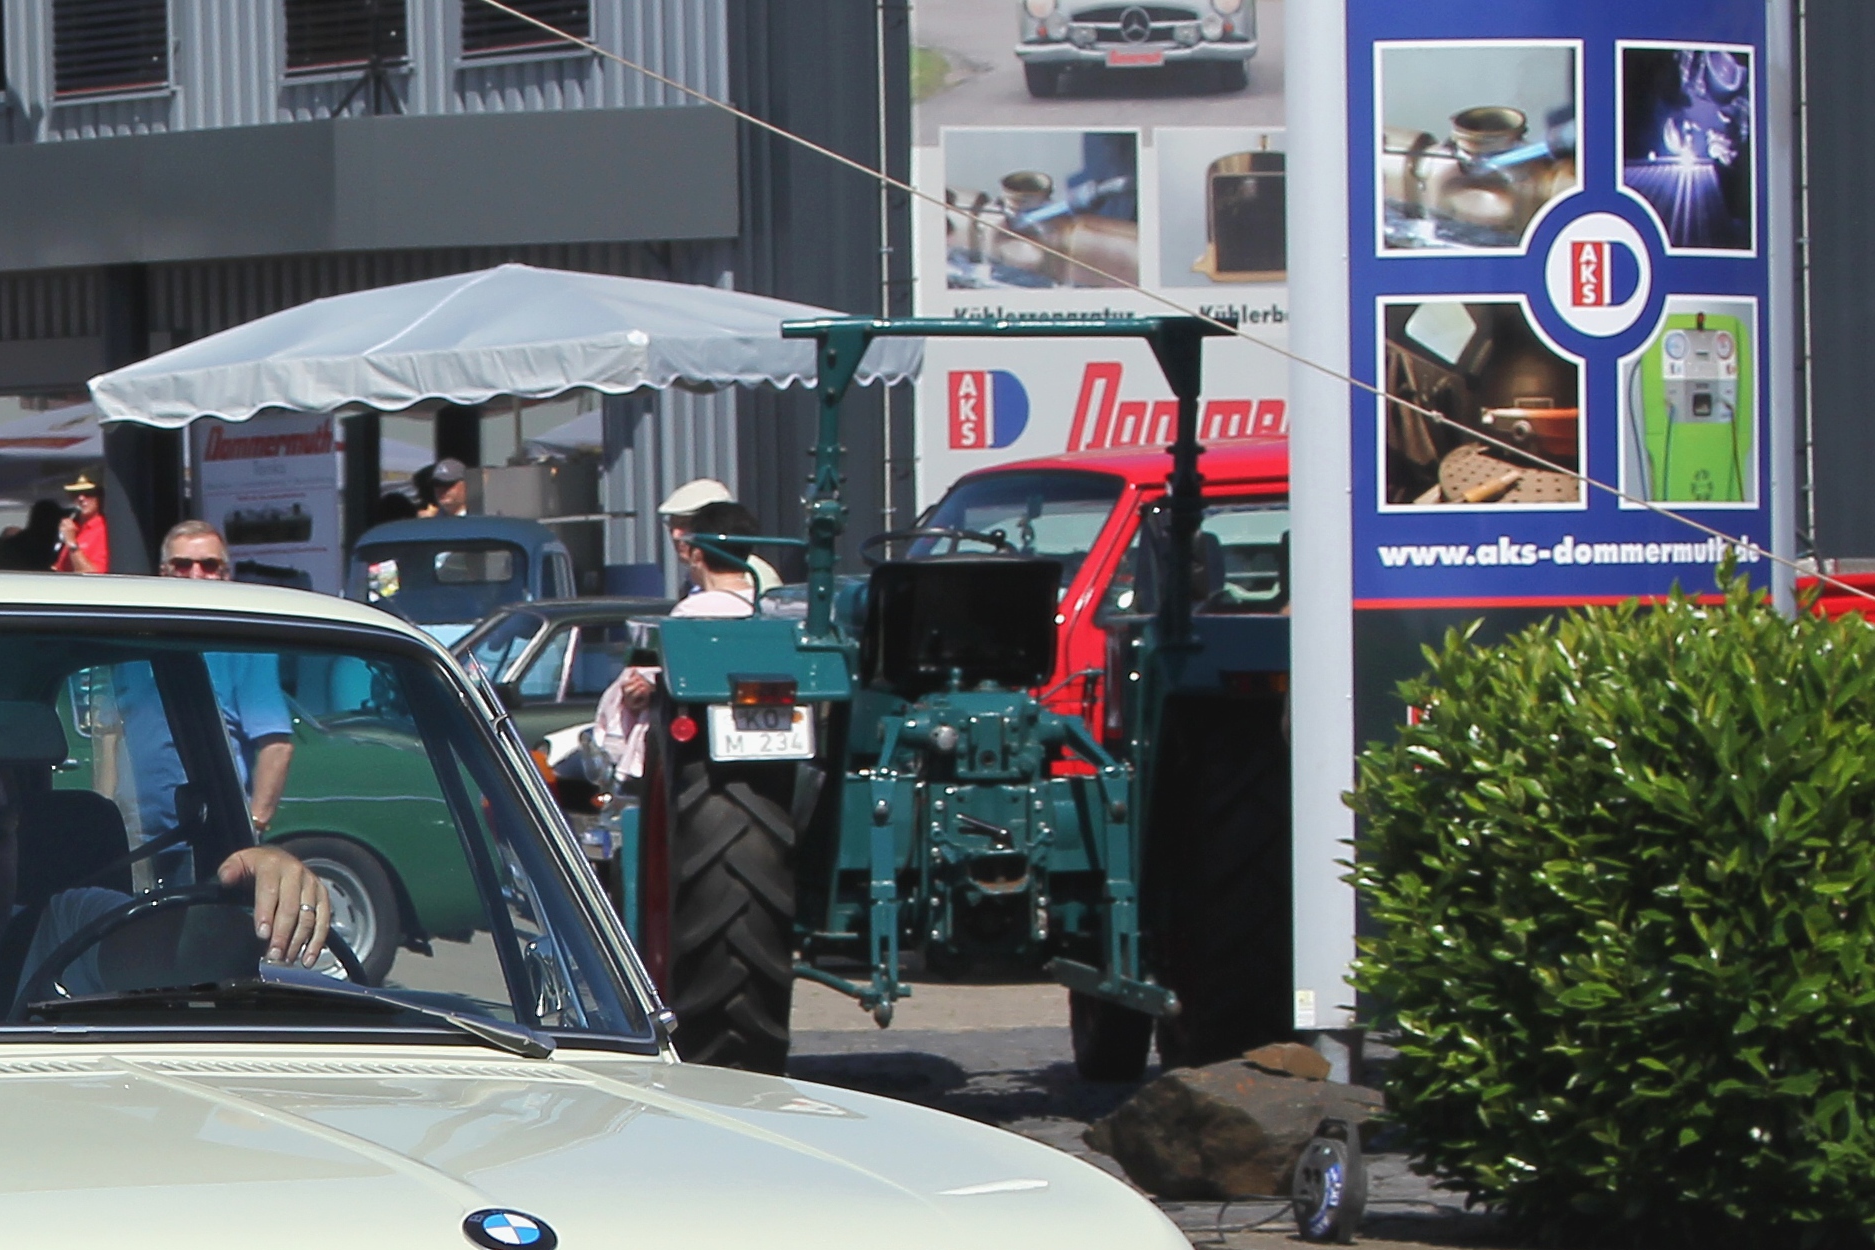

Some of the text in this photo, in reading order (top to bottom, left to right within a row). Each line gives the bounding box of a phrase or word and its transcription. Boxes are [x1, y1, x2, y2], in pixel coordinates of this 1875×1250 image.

[1578, 242, 1598, 305] AKS
[958, 373, 976, 446] AKS
[1067, 361, 1290, 452] Domme
[1377, 535, 1760, 566] www.aks-dommermuthde
[746, 709, 779, 729] KO
[725, 734, 744, 753] M
